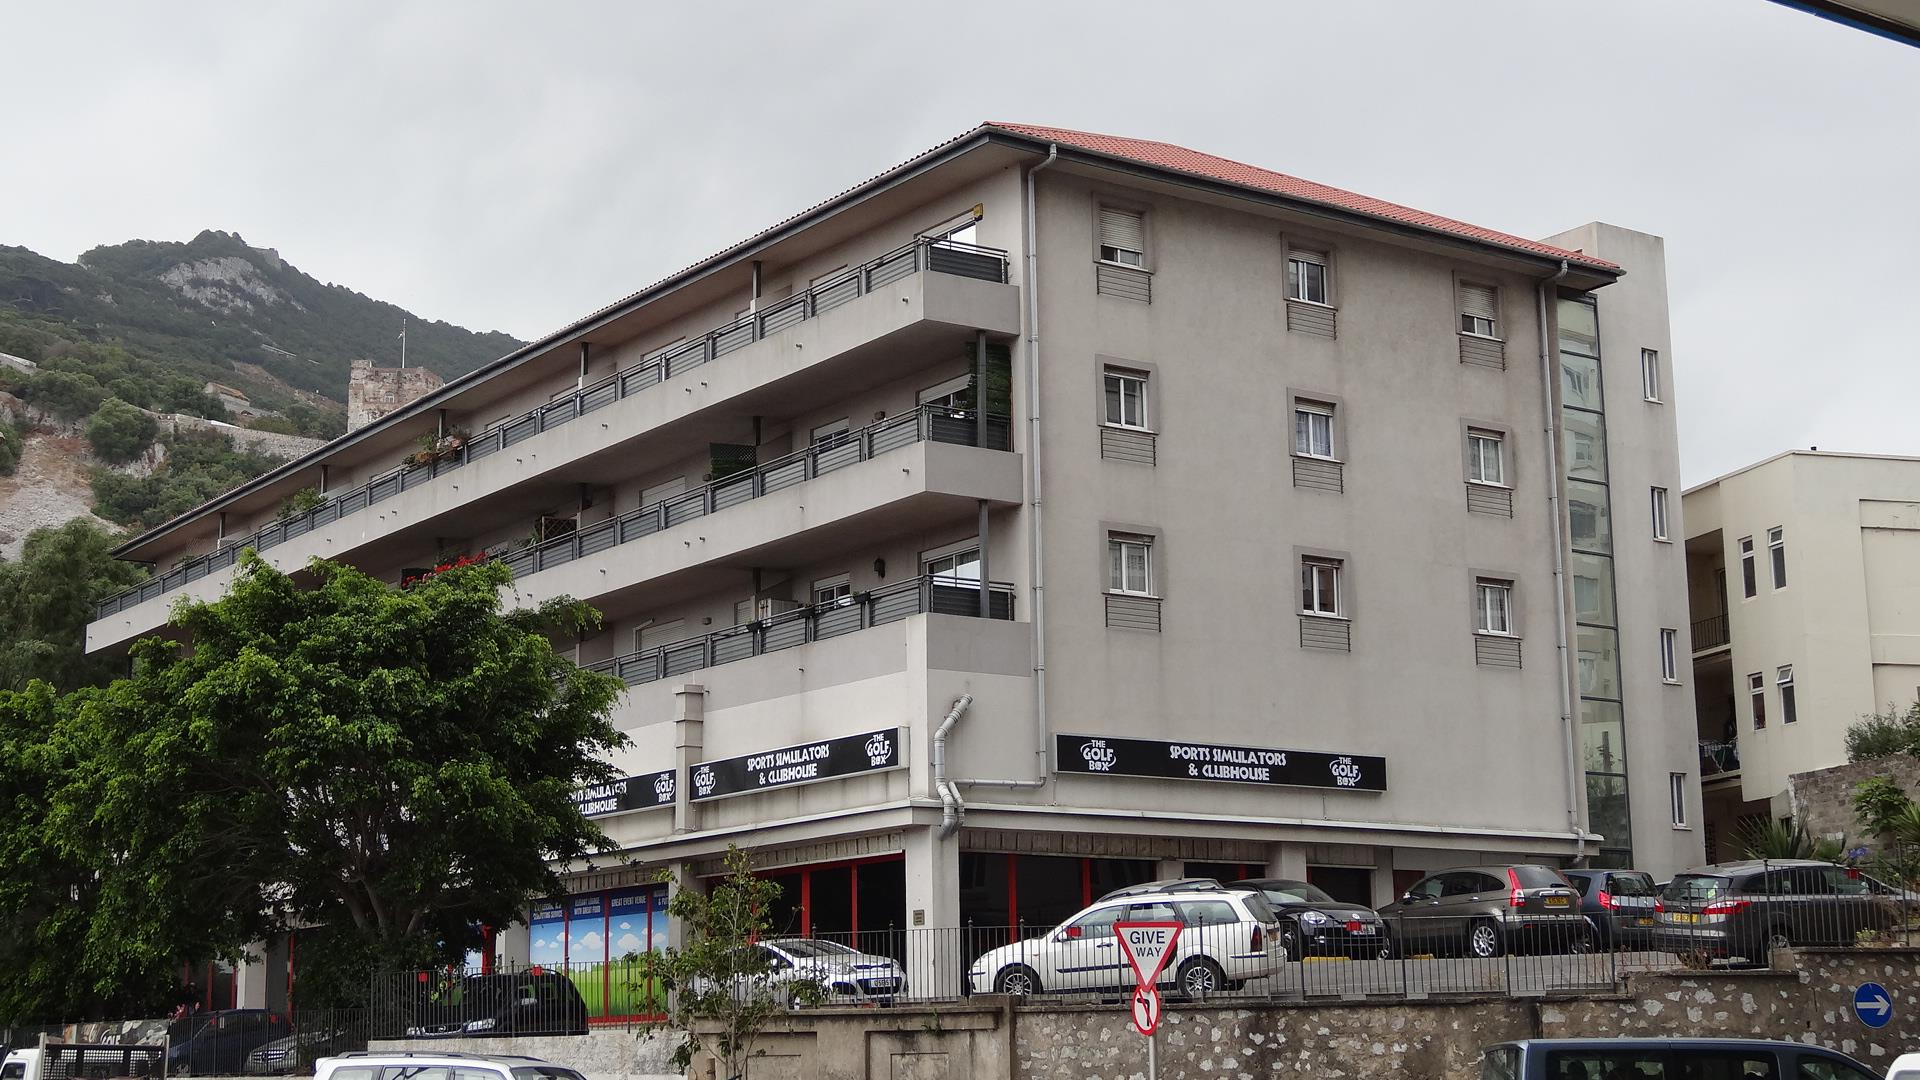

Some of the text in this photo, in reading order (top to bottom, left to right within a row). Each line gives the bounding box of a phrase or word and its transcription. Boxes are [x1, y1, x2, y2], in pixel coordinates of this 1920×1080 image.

[873, 734, 884, 742] THE
[1091, 740, 1106, 748] THE
[866, 740, 890, 757] GOLF
[1082, 748, 1114, 762] GOLF
[747, 744, 830, 772] SPORTS SIMULATORS
[870, 754, 886, 767] BOX
[1170, 745, 1287, 766] SPORTS SIMULATORS
[1338, 756, 1352, 765] THE
[700, 766, 710, 774] THE
[1089, 760, 1109, 772] BOX
[1331, 764, 1359, 778] GOLF
[661, 773, 670, 781] THE
[759, 763, 818, 786] & CLUBHOUSE
[1188, 764, 1270, 782] & CLUBHOUSE
[656, 779, 674, 793] GOLF
[695, 772, 715, 788] GOLF
[1336, 776, 1355, 786] BOX
[698, 784, 712, 796] BOX
[658, 792, 671, 802] BOX
[579, 798, 618, 815] CLUBHOUSE
[1130, 931, 1166, 944] GIVE
[1136, 947, 1162, 957] WAY
